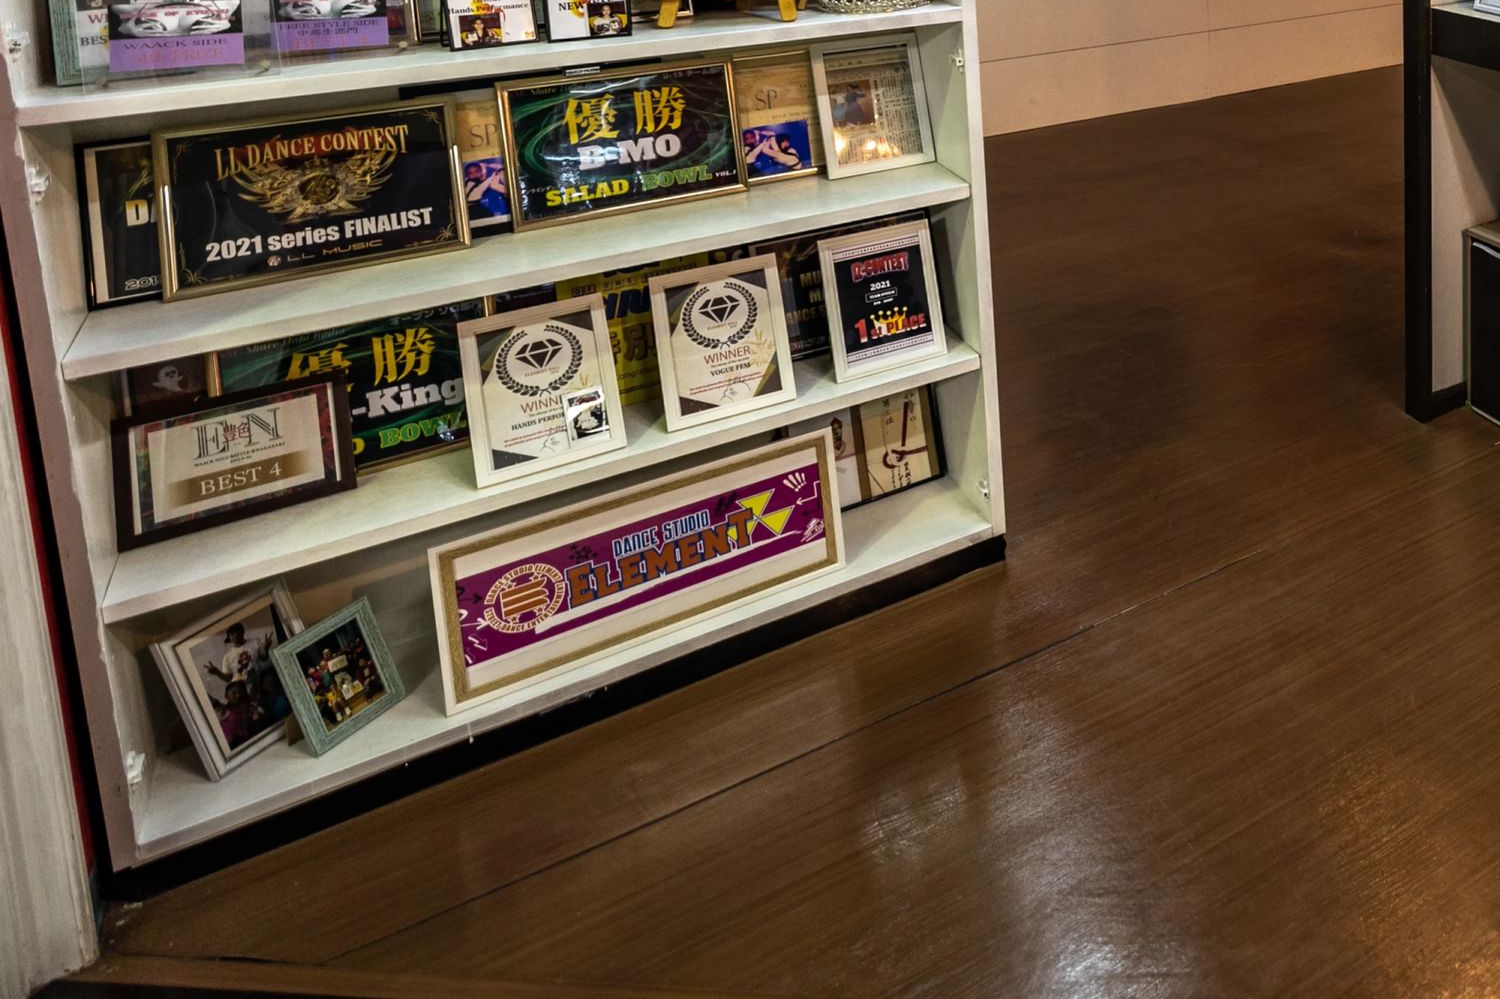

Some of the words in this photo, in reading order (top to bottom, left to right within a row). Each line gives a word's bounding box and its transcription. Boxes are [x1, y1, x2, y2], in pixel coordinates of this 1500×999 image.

[558, 1, 584, 12] NEW
[124, 40, 187, 50] WAACK
[192, 38, 229, 47] SIDE
[564, 87, 686, 145] 優勝
[214, 147, 243, 181] LL
[247, 134, 316, 167] DANCE
[321, 124, 410, 154] CONTEST
[547, 179, 630, 207] SALAD
[642, 165, 712, 192] BOWL
[206, 235, 263, 262] 2021
[267, 224, 340, 252] series
[344, 207, 434, 239] FINALIST
[322, 238, 384, 256] MUSIC
[870, 280, 891, 291] 2021
[886, 313, 927, 334] PLACE
[704, 346, 751, 366] WINNER
[710, 366, 729, 378] VOGUE
[380, 411, 468, 450] BOWL
[511, 417, 536, 431] HANDS
[200, 466, 262, 496] BEST
[270, 464, 282, 477] 4
[612, 527, 659, 558] DANCE
[663, 508, 711, 542] STUDIO
[565, 507, 756, 611] ELEMENT
